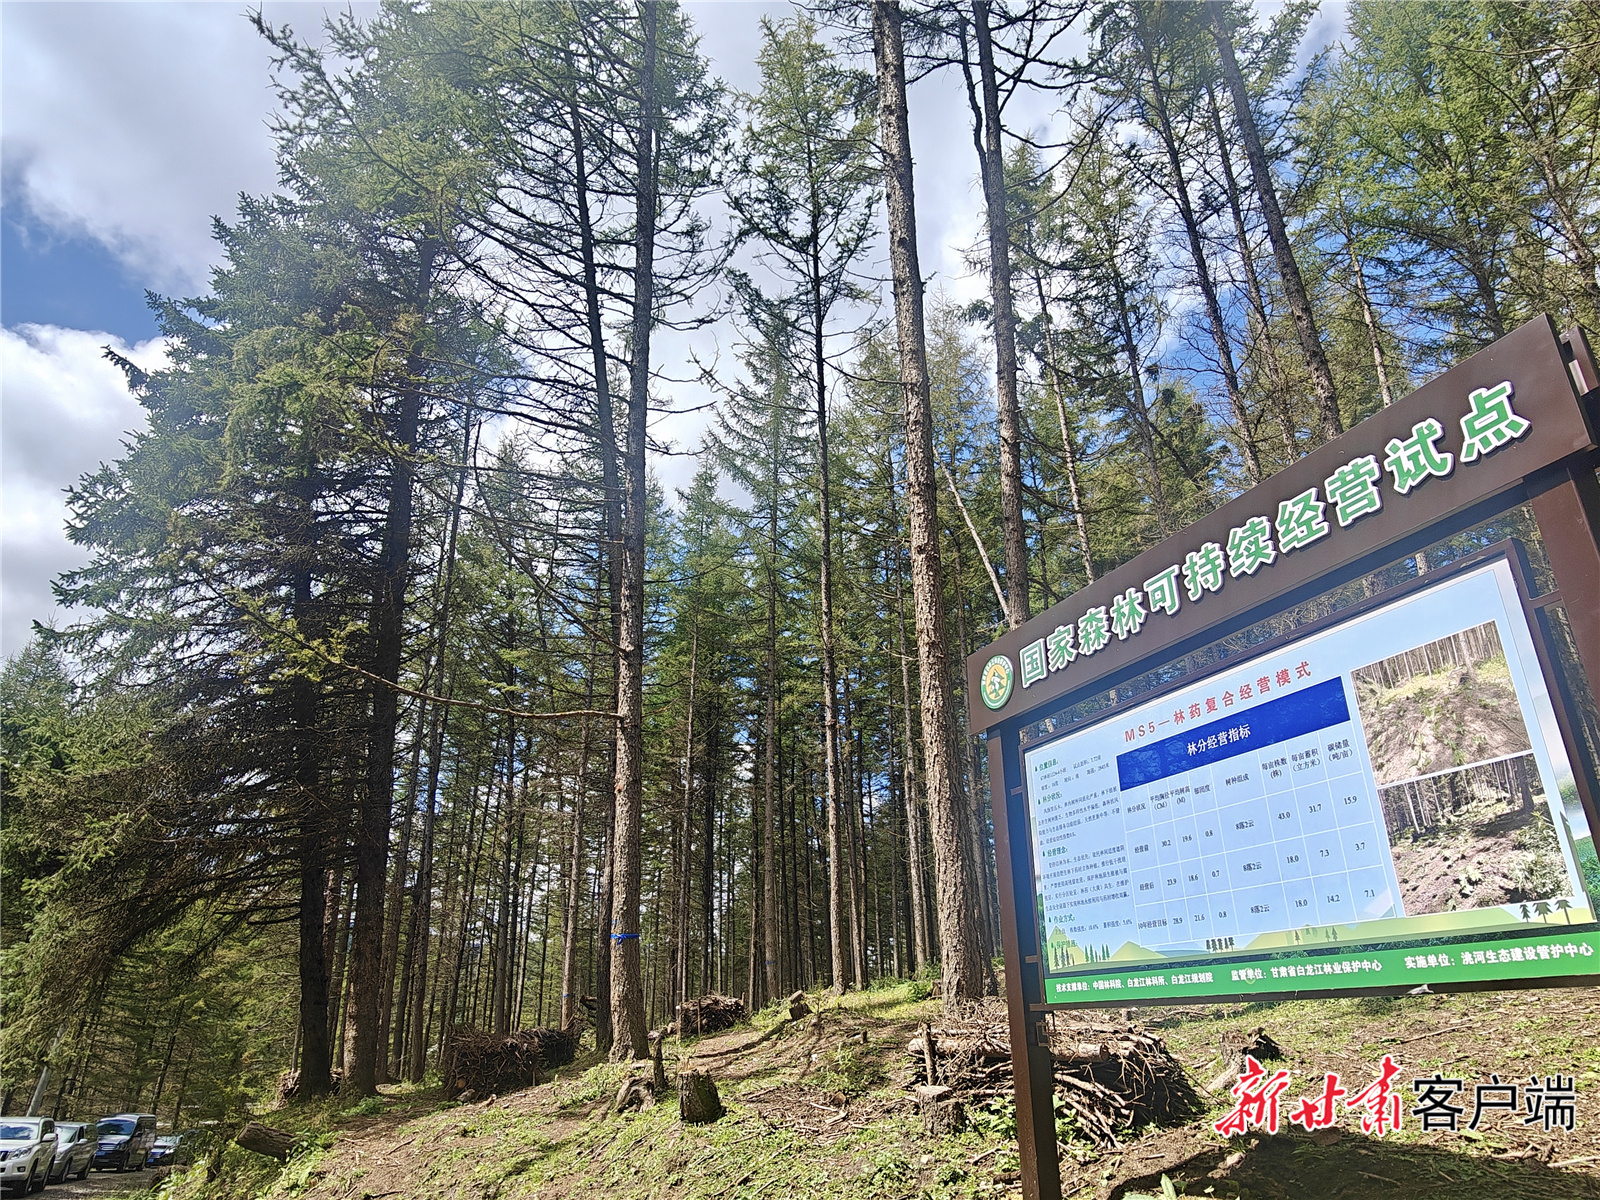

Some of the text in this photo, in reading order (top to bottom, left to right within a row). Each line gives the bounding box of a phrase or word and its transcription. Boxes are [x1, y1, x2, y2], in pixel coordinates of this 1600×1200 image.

[1019, 380, 1531, 689] 国家森林可持续经营试点
[1186, 724, 1251, 756] 林分经营指标
[1261, 757, 1288, 771] 每亩株数
[1182, 834, 1192, 843] 19.6
[1205, 829, 1213, 838] 0.8
[1277, 811, 1291, 820] 43.0
[1308, 804, 1322, 814] 31.7
[1343, 795, 1358, 806] 15.9
[1188, 874, 1199, 882] 18.6
[1211, 870, 1220, 878] 0.7
[1286, 854, 1299, 864] 18.0
[1319, 849, 1330, 858] 7.3
[1355, 842, 1366, 851] 3.7
[1194, 914, 1205, 922] 21.6
[1218, 911, 1227, 919] 0.8
[1294, 899, 1308, 908] 18.0
[1326, 894, 1341, 904] 14.2
[1364, 889, 1375, 898] 7.1
